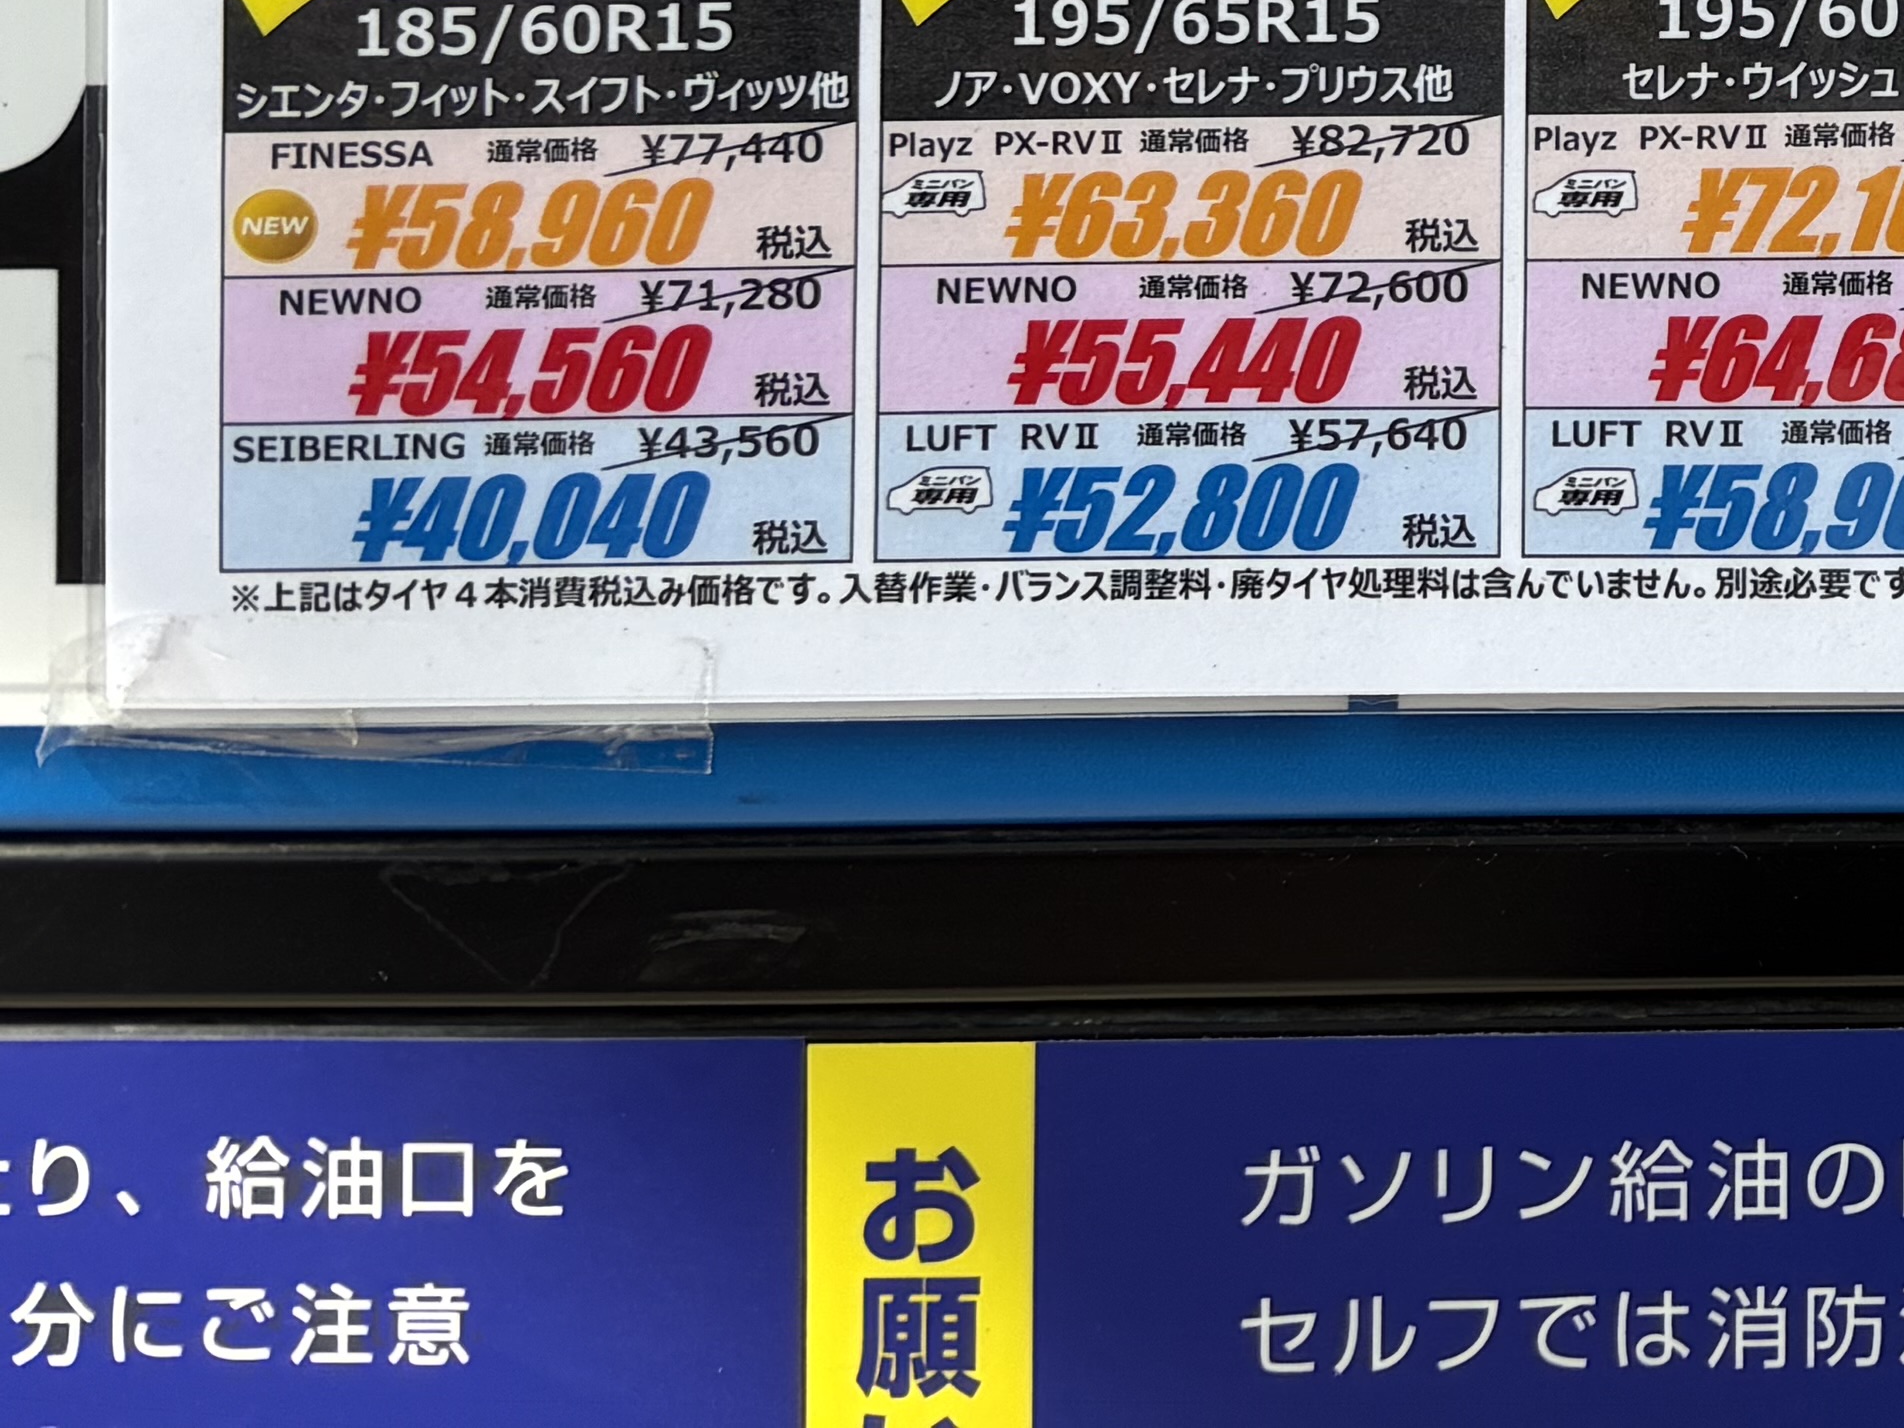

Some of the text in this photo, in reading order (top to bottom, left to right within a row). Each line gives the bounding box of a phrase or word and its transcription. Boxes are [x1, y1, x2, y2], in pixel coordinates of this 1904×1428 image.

[358, 2, 732, 64] 185/60R15
[890, 132, 972, 163] Playz
[348, 180, 712, 269] ¥58,960
[905, 171, 1361, 263] 専用 ¥63,360
[907, 424, 997, 451] LUFT
[1289, 417, 1467, 455] ¥57,640
[353, 472, 709, 568] ¥40,040
[1003, 464, 1359, 559] ¥52,800
[0, 1136, 571, 1220] り、給油口を
[9, 1282, 473, 1367] 分にご注意
[855, 1146, 982, 1428] お願
